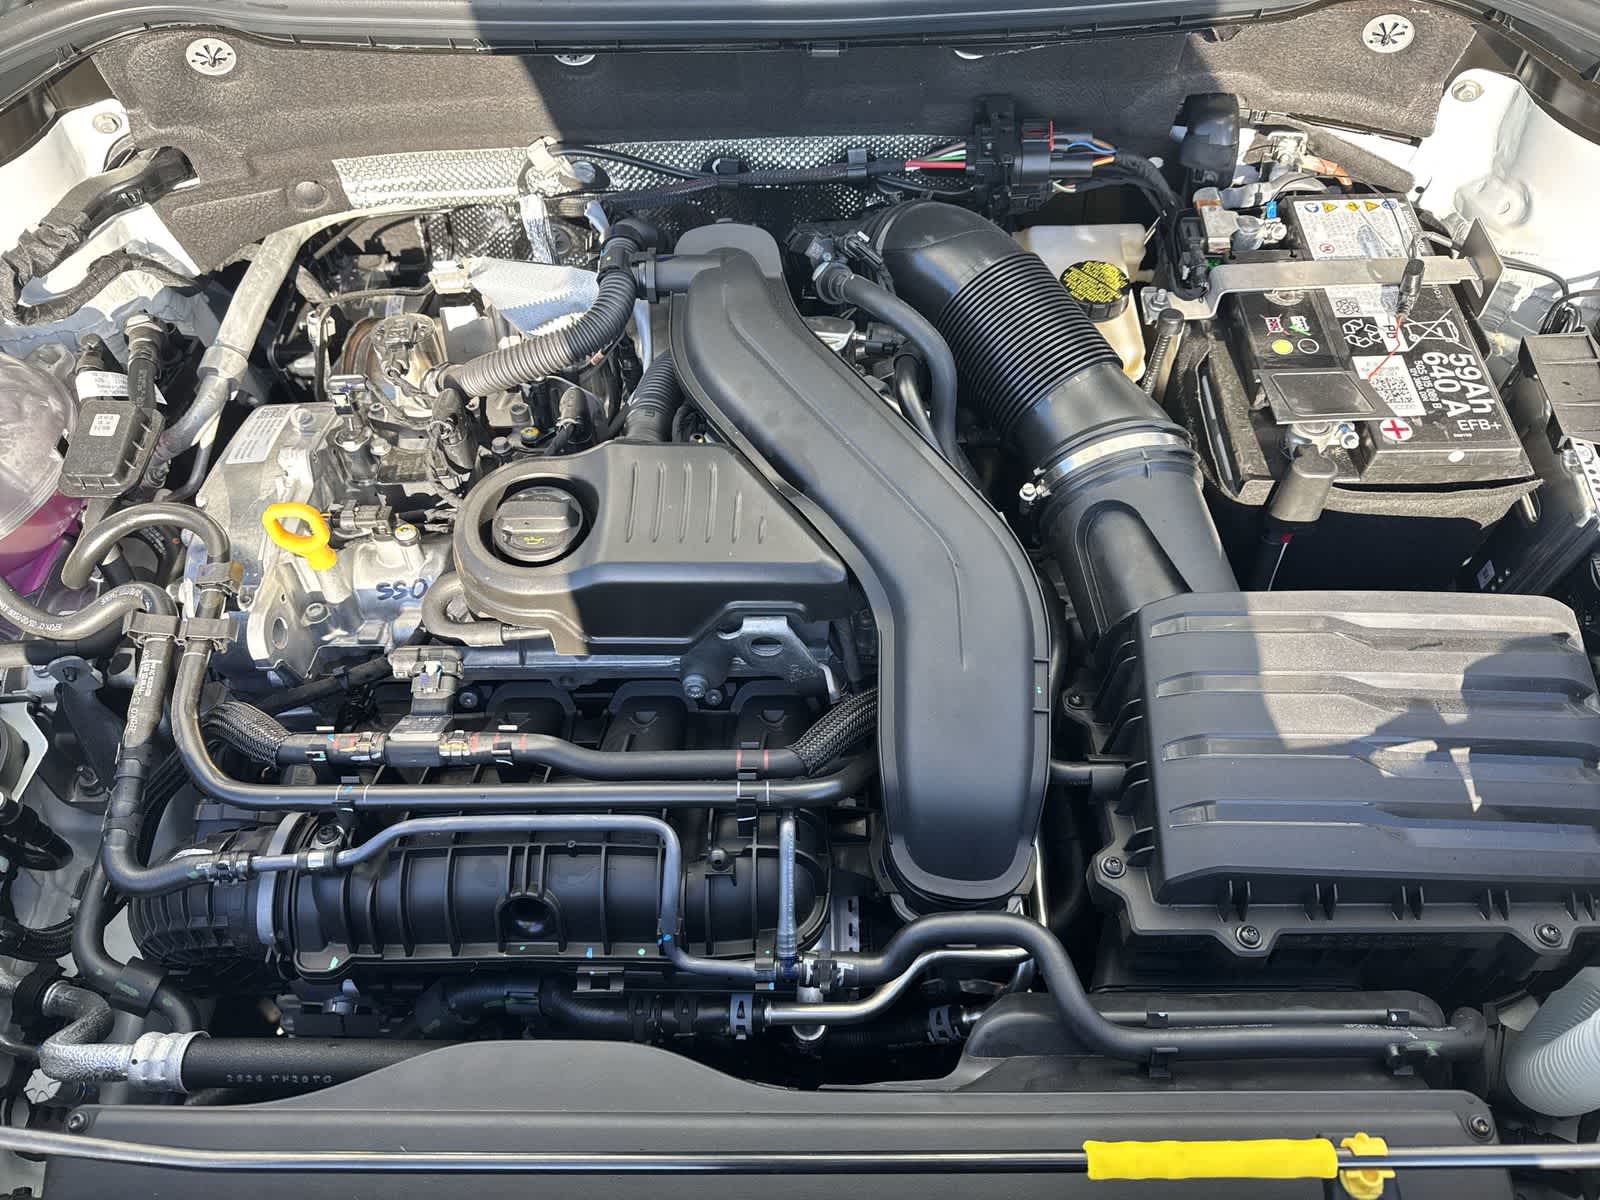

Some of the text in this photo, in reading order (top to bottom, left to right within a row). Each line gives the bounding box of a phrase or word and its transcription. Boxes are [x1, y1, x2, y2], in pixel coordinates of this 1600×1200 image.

[1422, 352, 1461, 393] 640
[1448, 353, 1496, 414] 59Ah
[1440, 399, 1472, 418] A
[1457, 419, 1502, 431] EFB+
